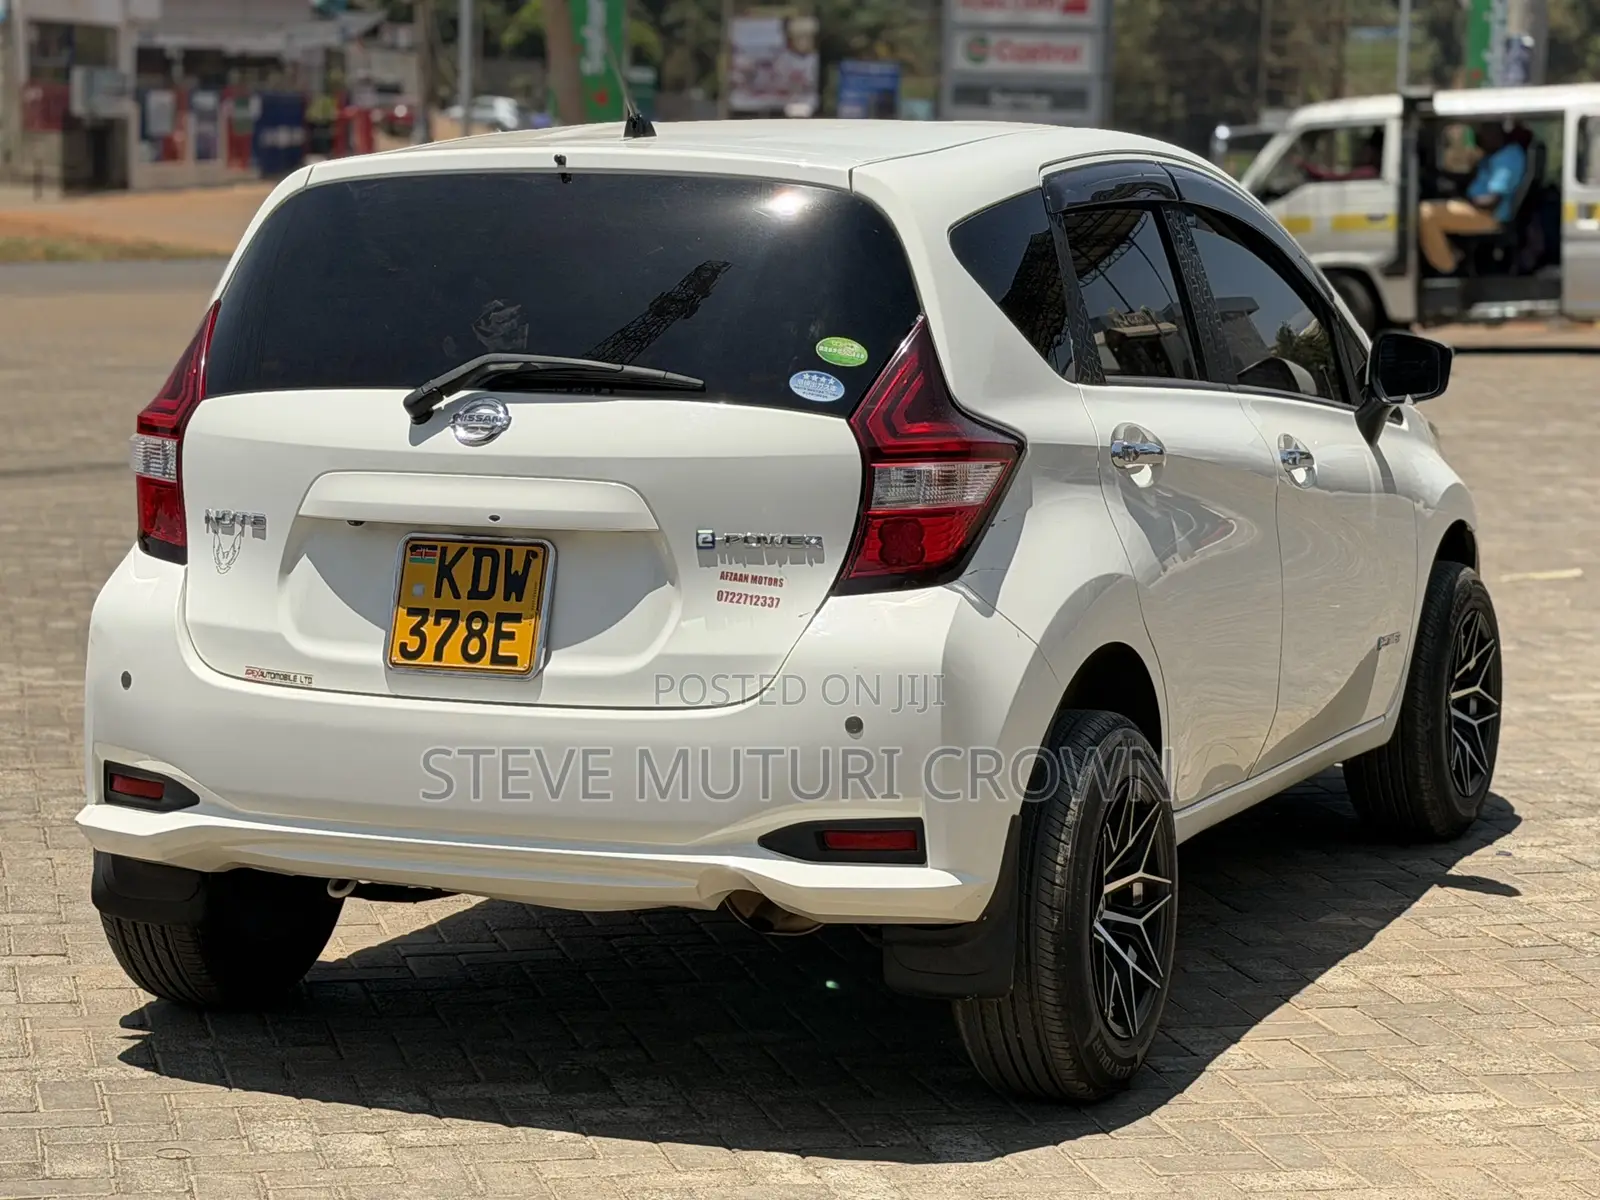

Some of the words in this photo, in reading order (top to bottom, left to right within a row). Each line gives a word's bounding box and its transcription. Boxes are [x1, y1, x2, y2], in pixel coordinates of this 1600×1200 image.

[453, 412, 505, 425] NISSAN
[434, 546, 536, 602] KDW
[719, 570, 749, 583] AFZAAN
[750, 573, 784, 588] MOTORS
[716, 589, 781, 609] 0722712337
[399, 607, 523, 666] 378E
[299, 675, 313, 685] LTD
